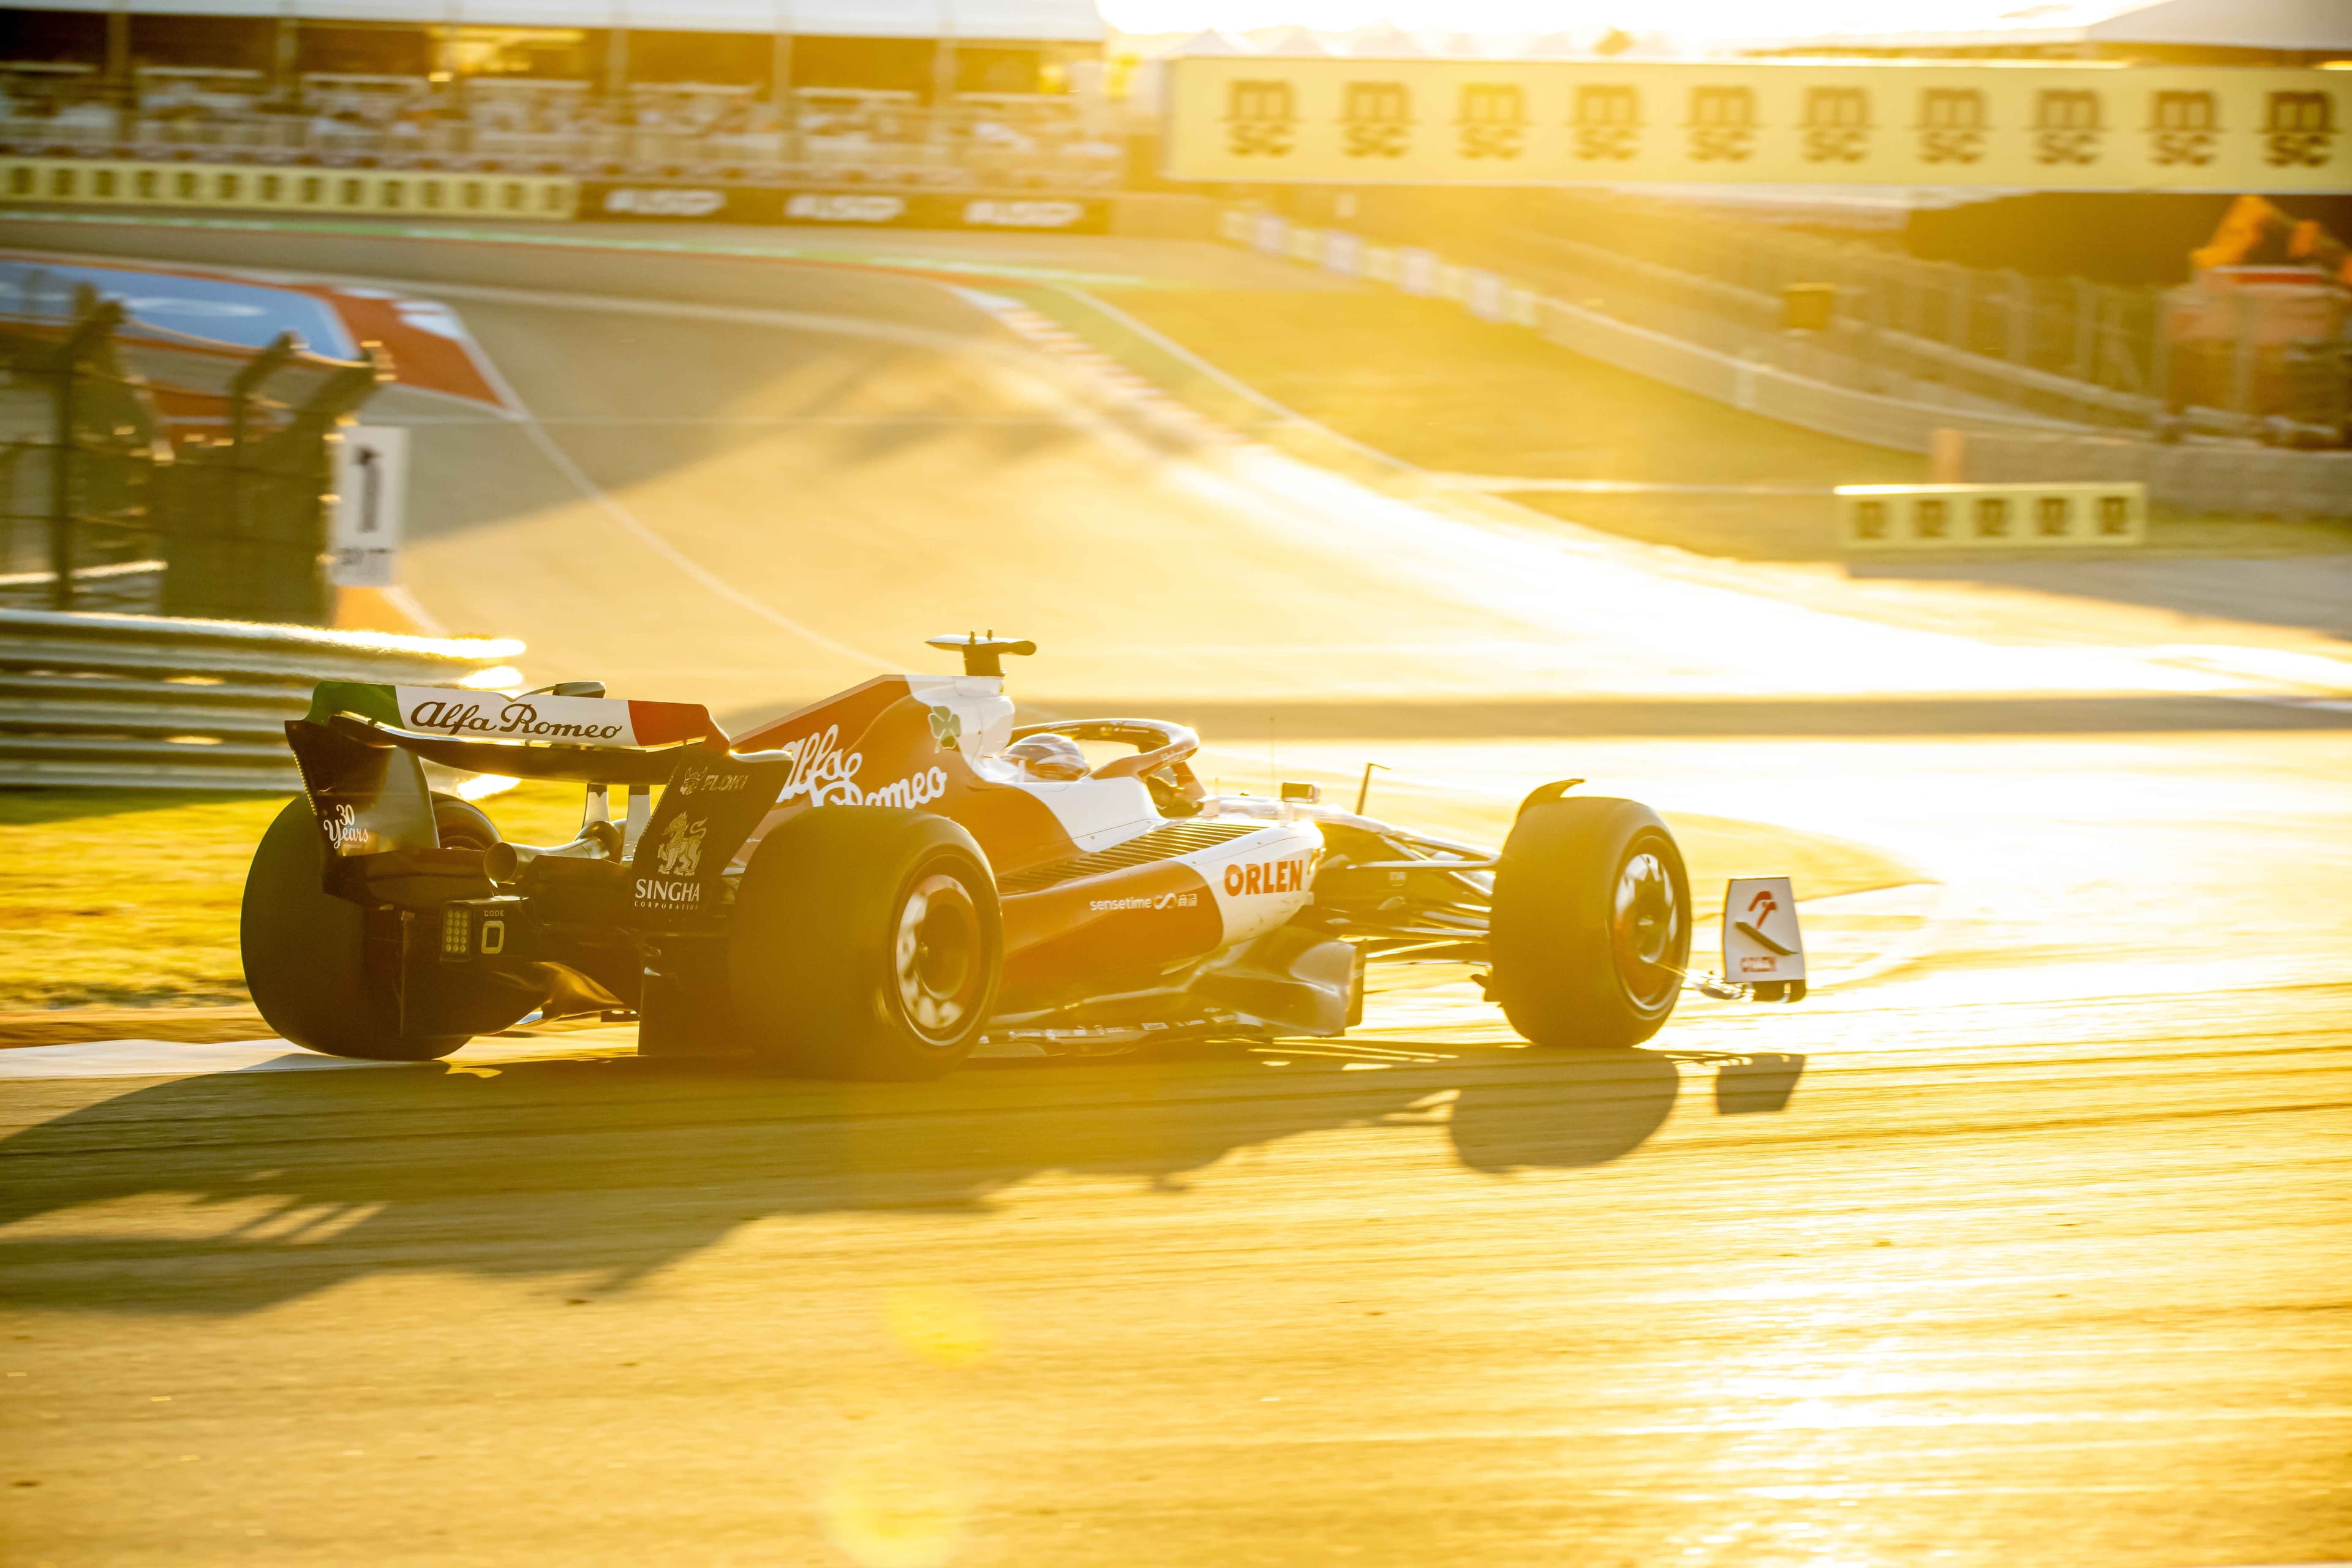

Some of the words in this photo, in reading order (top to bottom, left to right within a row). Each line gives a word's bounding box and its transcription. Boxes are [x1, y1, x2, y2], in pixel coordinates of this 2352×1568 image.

[354, 443, 381, 533] 1
[410, 701, 497, 736] Alfa
[499, 703, 623, 739] Romeo
[336, 804, 355, 826] 30
[323, 820, 369, 849] Years
[635, 878, 700, 902] SINGHA
[1224, 859, 1303, 897] ORLEN
[635, 900, 699, 910] CORPORATION
[1090, 896, 1152, 911] sensetime
